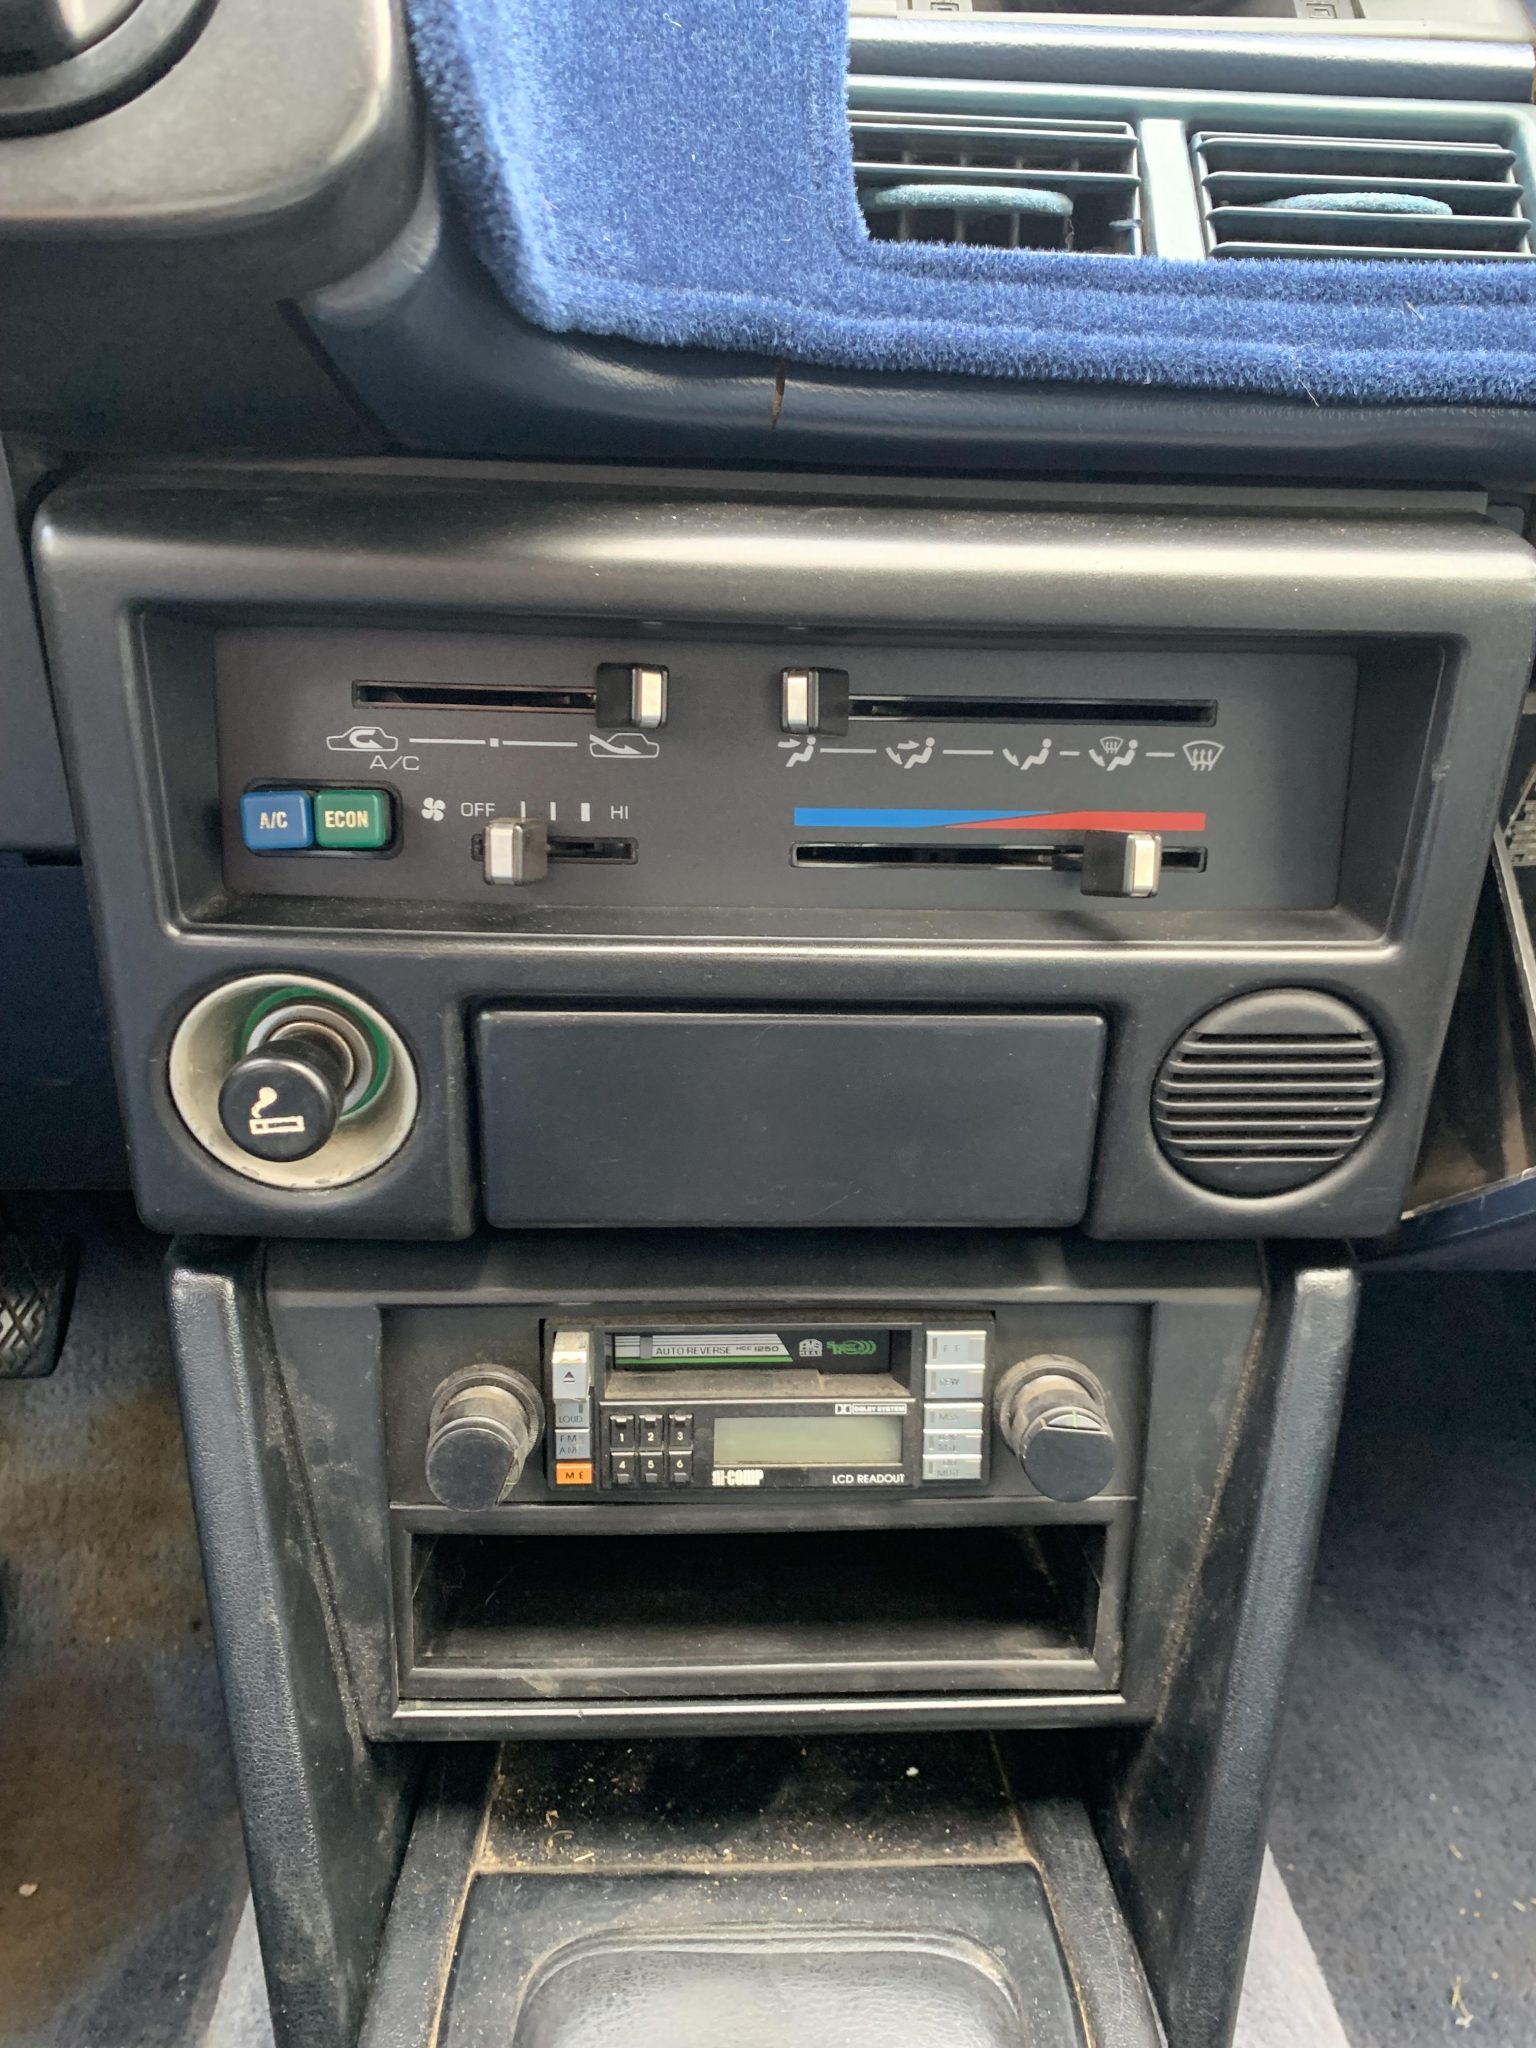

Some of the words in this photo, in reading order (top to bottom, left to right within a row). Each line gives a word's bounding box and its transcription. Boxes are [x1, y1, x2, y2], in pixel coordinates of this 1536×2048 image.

[369, 755, 420, 771] A/C
[460, 802, 496, 818] OFF
[610, 805, 629, 820] HI
[259, 811, 288, 829] A/C
[324, 810, 369, 828] ECON
[655, 1346, 685, 1356] AUTO
[687, 1345, 731, 1355] REVERSE
[753, 1345, 780, 1353] 1250
[558, 1414, 583, 1424] LOUD
[619, 1433, 625, 1442] 1
[647, 1432, 655, 1442] 2
[676, 1431, 684, 1441] 3
[618, 1460, 626, 1469] 4
[647, 1460, 655, 1469] 5
[676, 1459, 684, 1469] 6
[832, 1474, 854, 1485] LCD
[857, 1473, 906, 1484] READOUT
